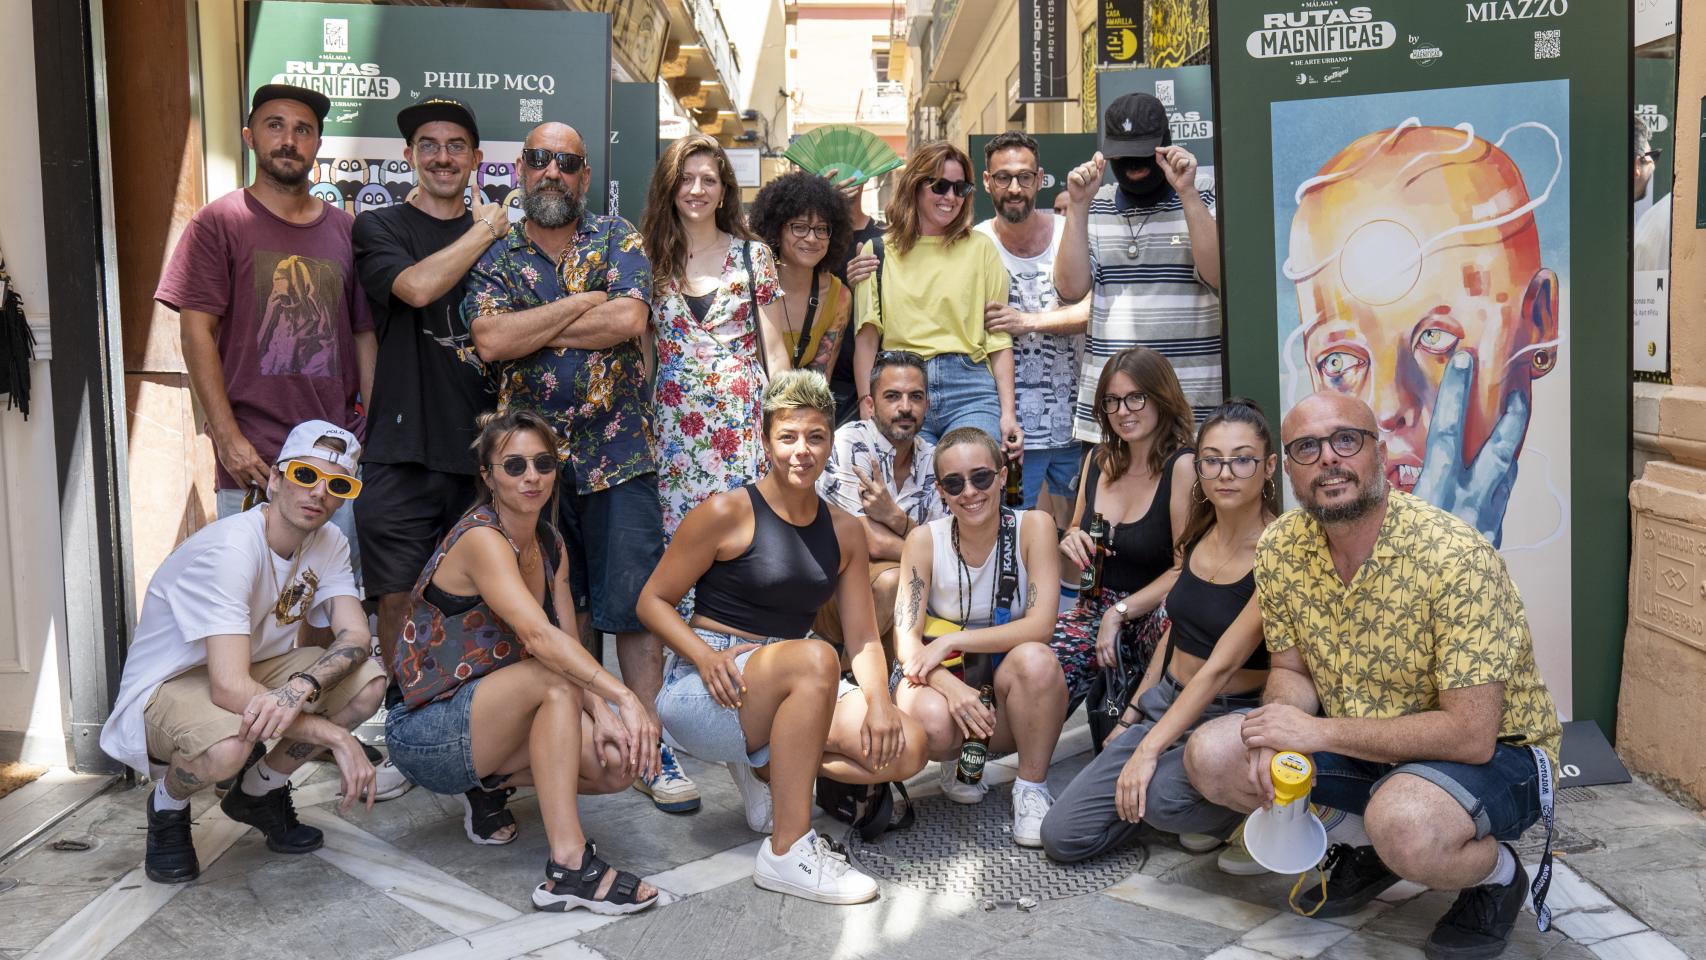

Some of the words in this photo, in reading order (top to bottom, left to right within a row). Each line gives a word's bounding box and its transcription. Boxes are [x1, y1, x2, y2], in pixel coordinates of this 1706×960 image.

[1263, 7, 1372, 29] RUTAS
[1466, 0, 1568, 23] MIAZZO
[1260, 23, 1383, 56] MAGNÍFICAS
[1408, 34, 1420, 45] by
[1322, 56, 1348, 64] URBANO
[286, 61, 381, 76] RUTAS
[424, 71, 500, 90] PHILIP
[504, 75, 555, 95] MCQ
[410, 90, 421, 99] by
[960, 751, 985, 765] MAGNA
[799, 862, 812, 875] FILA
